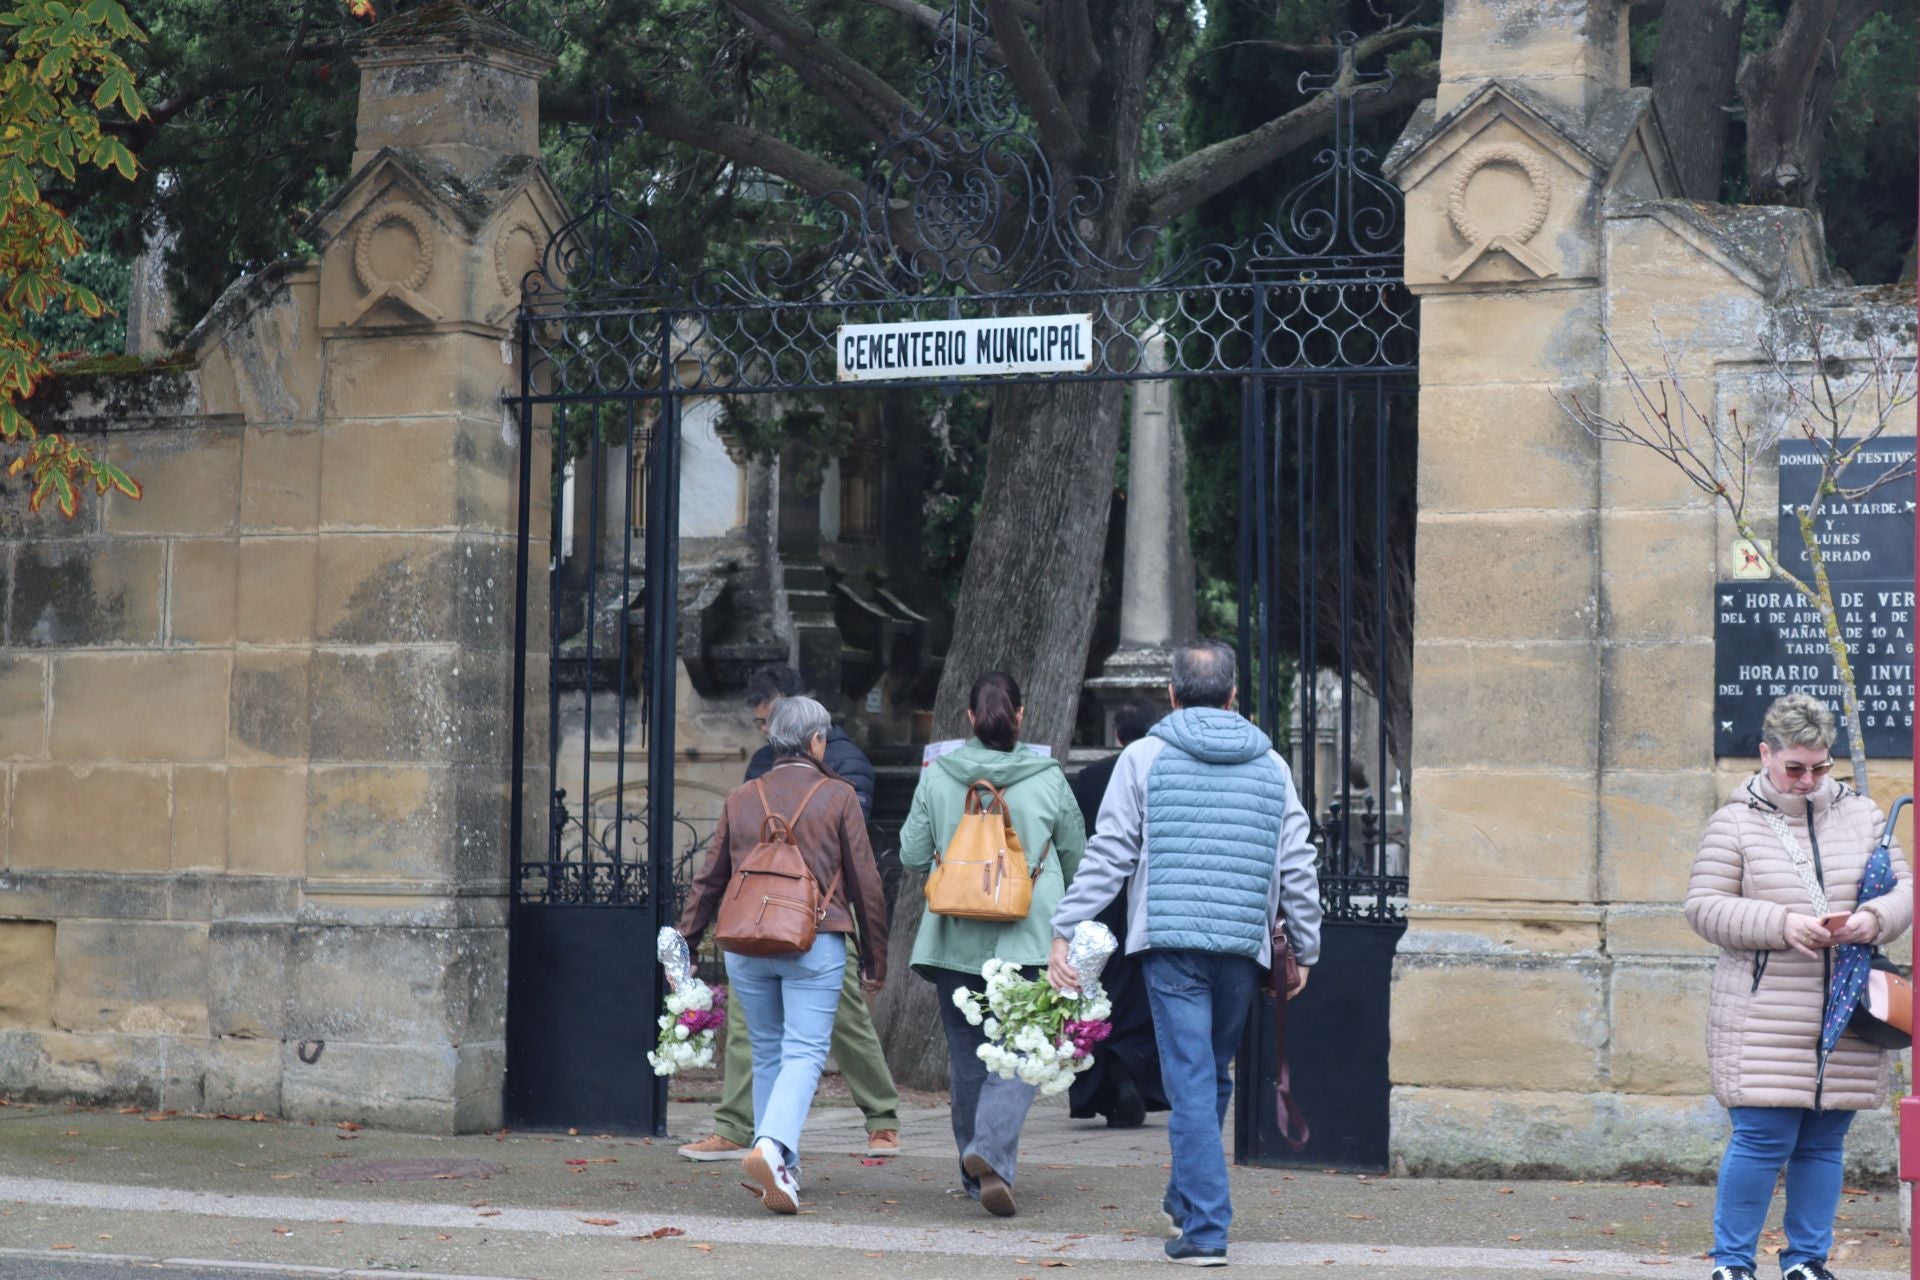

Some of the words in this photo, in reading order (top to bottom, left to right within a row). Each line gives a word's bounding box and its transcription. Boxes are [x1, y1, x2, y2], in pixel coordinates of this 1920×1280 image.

[844, 329, 966, 371] CEMENTERIO
[976, 323, 1085, 364] MUNICIPAL
[1857, 451, 1917, 464] FESTIVO
[1800, 504, 1826, 515] PR
[1831, 503, 1848, 515] LA
[1852, 503, 1902, 514] TARDE.
[1825, 519, 1835, 531] Y
[1814, 533, 1860, 545] LUNES
[1800, 550, 1871, 562] CRRADO
[1745, 593, 1815, 609] HORAR
[1841, 592, 1864, 608] DE
[1878, 591, 1916, 607] VER
[1721, 612, 1746, 624] DEL
[1754, 612, 1761, 624] 1
[1769, 612, 1786, 623] DE
[1793, 611, 1822, 623] ABR
[1845, 611, 1863, 623] AL
[1870, 611, 1877, 623] 1
[1891, 611, 1908, 622] DE
[1779, 624, 1828, 639] MAÑAN
[1846, 627, 1863, 638] DE
[1871, 627, 1887, 639] 10
[1895, 627, 1905, 638] A
[1785, 643, 1833, 655] TARDE
[1867, 643, 1876, 654] 3
[1886, 643, 1896, 654] A
[1905, 642, 1914, 653] 6
[1740, 665, 1819, 680] HORARIO
[1871, 665, 1912, 680] INVI
[1720, 684, 1744, 696] DEL
[1756, 684, 1762, 696] 1
[1769, 684, 1786, 696] DE
[1863, 684, 1881, 696] AL
[1887, 684, 1902, 696] 31
[1908, 684, 1915, 696] D
[1872, 700, 1887, 711] 10
[1891, 700, 1900, 711] A
[1908, 700, 1915, 711] 1
[1840, 715, 1848, 727] D
[1867, 715, 1876, 727] 3
[1885, 715, 1895, 727] A
[1904, 715, 1913, 727] 5
